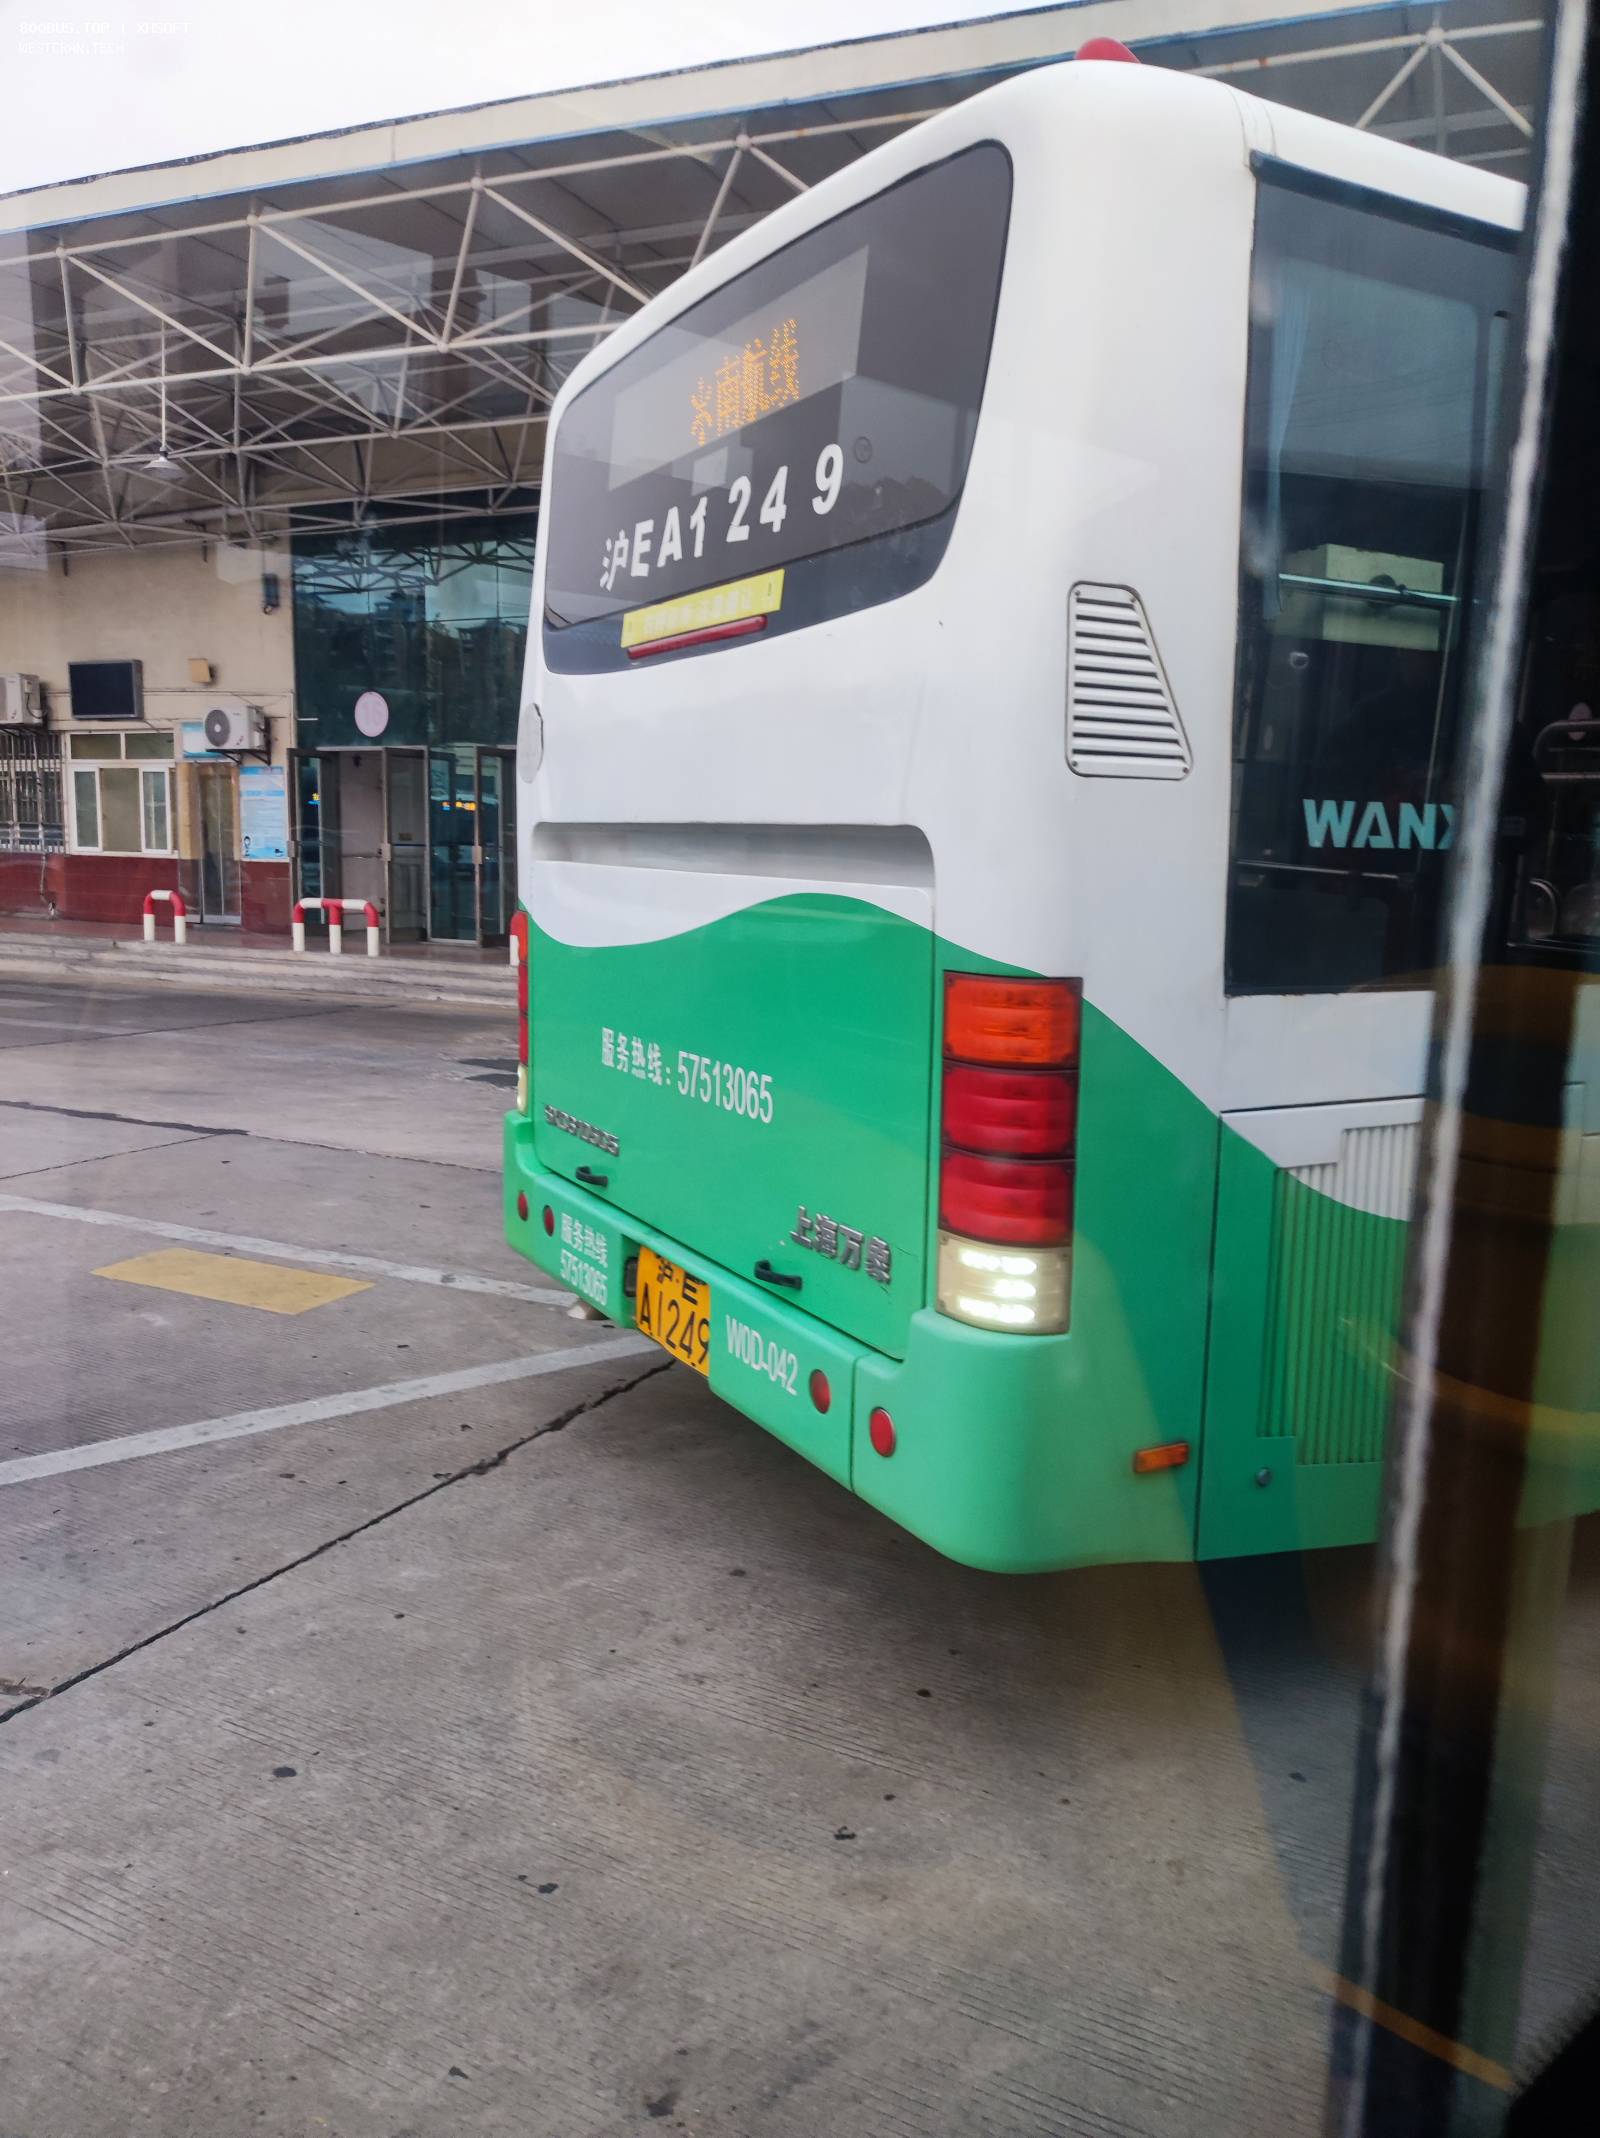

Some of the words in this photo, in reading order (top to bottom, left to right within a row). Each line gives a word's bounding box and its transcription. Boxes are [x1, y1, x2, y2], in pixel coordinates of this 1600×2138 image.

[677, 1050, 774, 1124] 57513065
[560, 1212, 609, 1269] 服务热线
[789, 1204, 892, 1285] 上海万象
[639, 1281, 710, 1365] A1249
